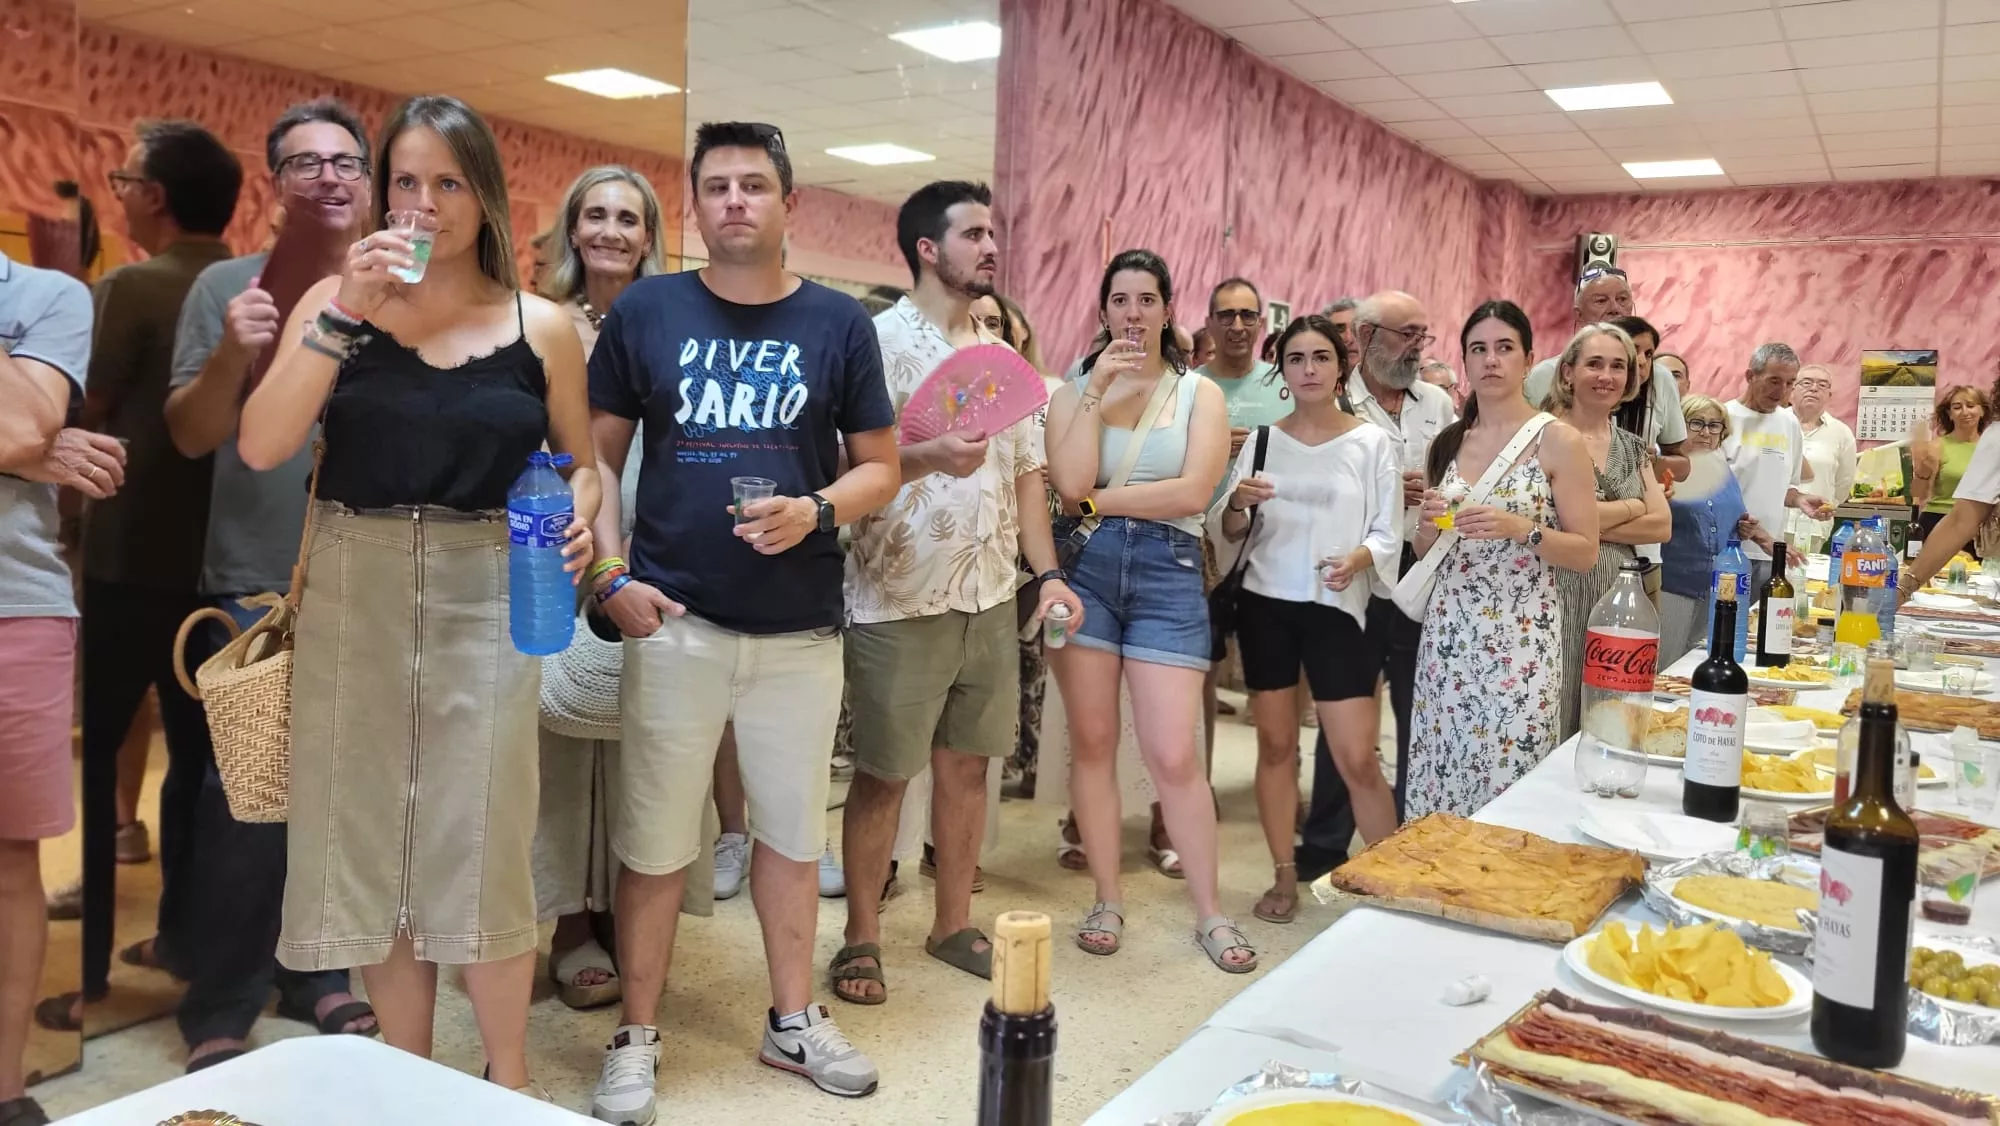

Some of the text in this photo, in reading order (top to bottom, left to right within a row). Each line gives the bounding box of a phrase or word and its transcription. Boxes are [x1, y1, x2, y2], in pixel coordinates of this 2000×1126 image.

[679, 338, 801, 377] DIVER
[674, 377, 808, 428] SARIO
[523, 515, 533, 524] EN
[1857, 558, 1887, 571] FANT
[1597, 674, 1618, 682] ZERO
[1693, 731, 1736, 747] COTO DE HAYAS
[1823, 917, 1851, 938] HAYAS
